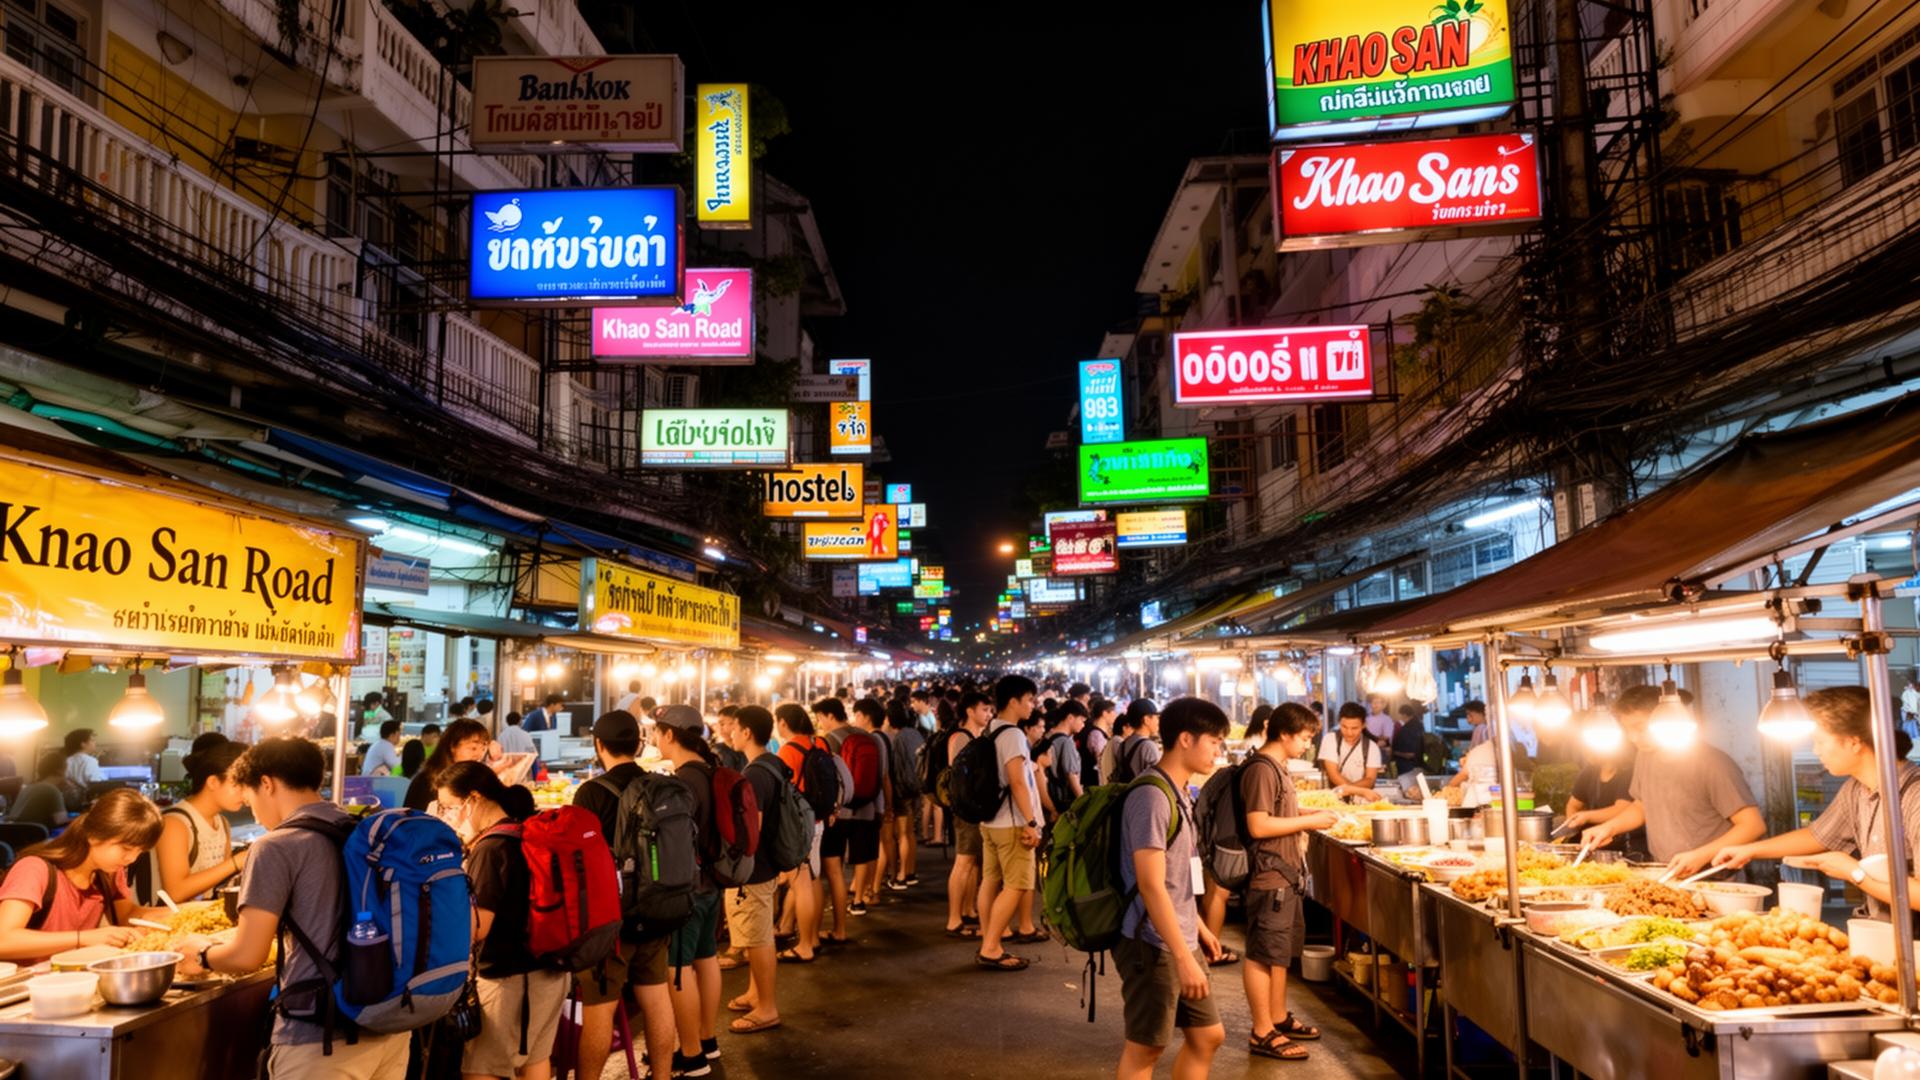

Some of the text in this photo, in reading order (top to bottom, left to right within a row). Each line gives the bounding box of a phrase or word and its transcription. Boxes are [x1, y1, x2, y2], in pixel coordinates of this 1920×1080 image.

[1293, 19, 1471, 87] KHAO SAN
[1293, 152, 1520, 210] Khao Sans
[602, 317, 742, 339] Khao San Road
[148, 526, 228, 589] San
[242, 546, 335, 609] Road
